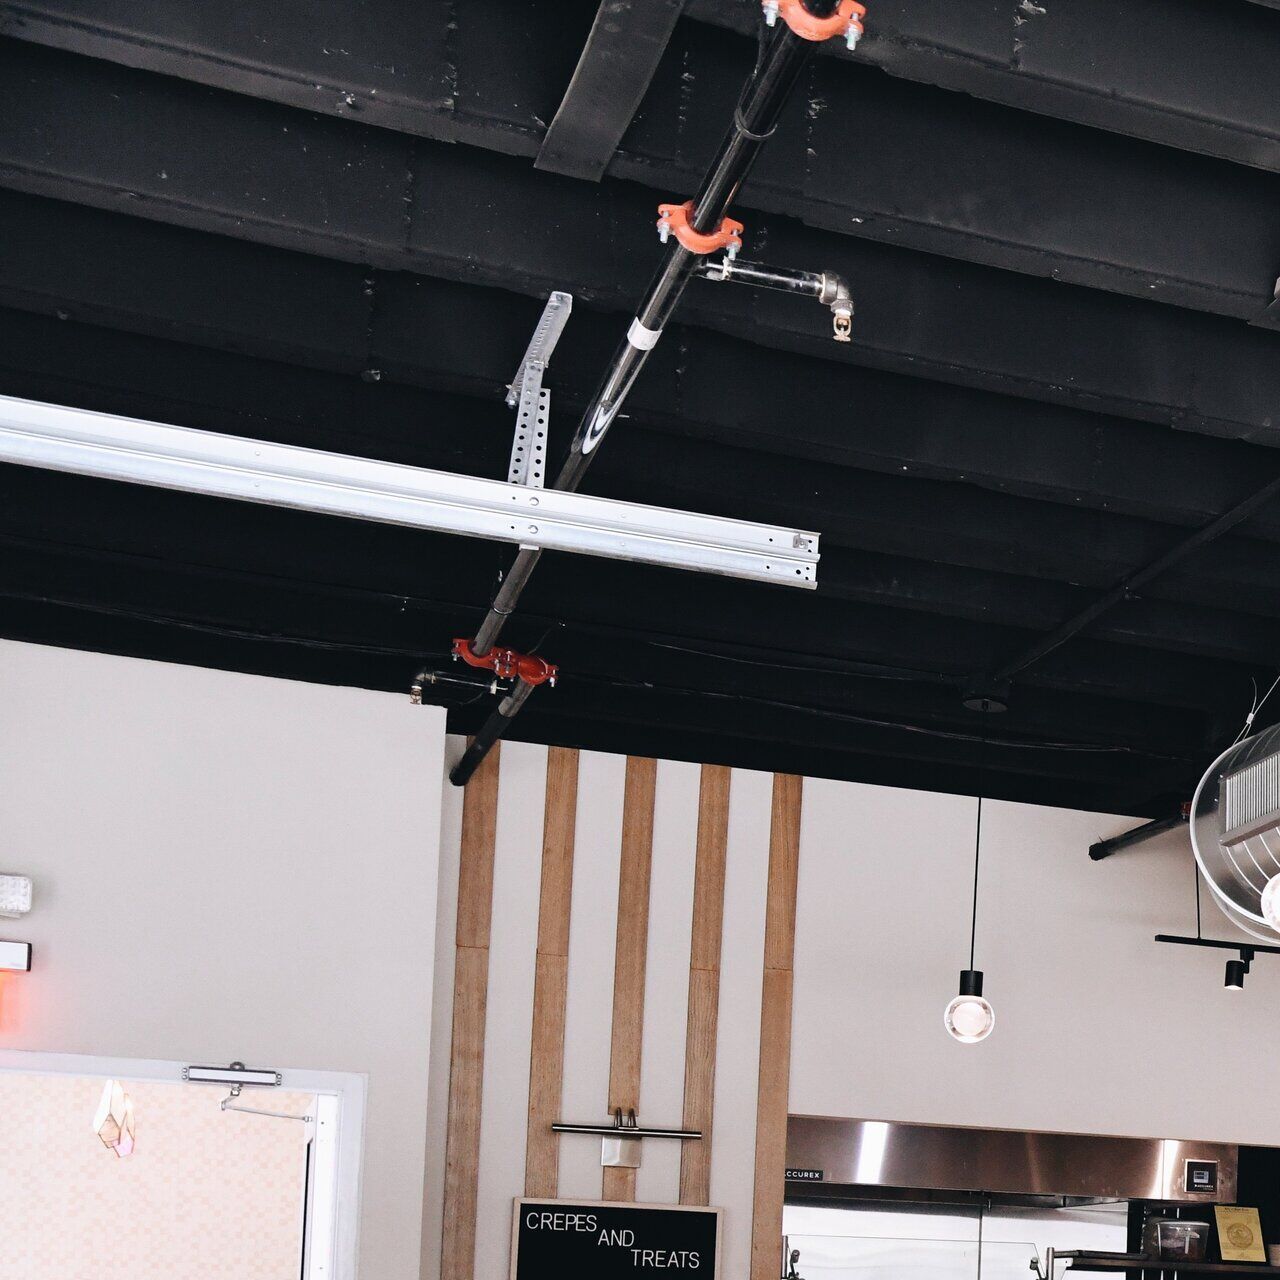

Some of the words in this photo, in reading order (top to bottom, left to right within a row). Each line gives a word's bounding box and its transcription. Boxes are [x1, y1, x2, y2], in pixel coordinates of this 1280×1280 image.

[526, 1212, 597, 1232] CREPES
[597, 1229, 635, 1247] AND
[631, 1249, 700, 1269] TREATS
